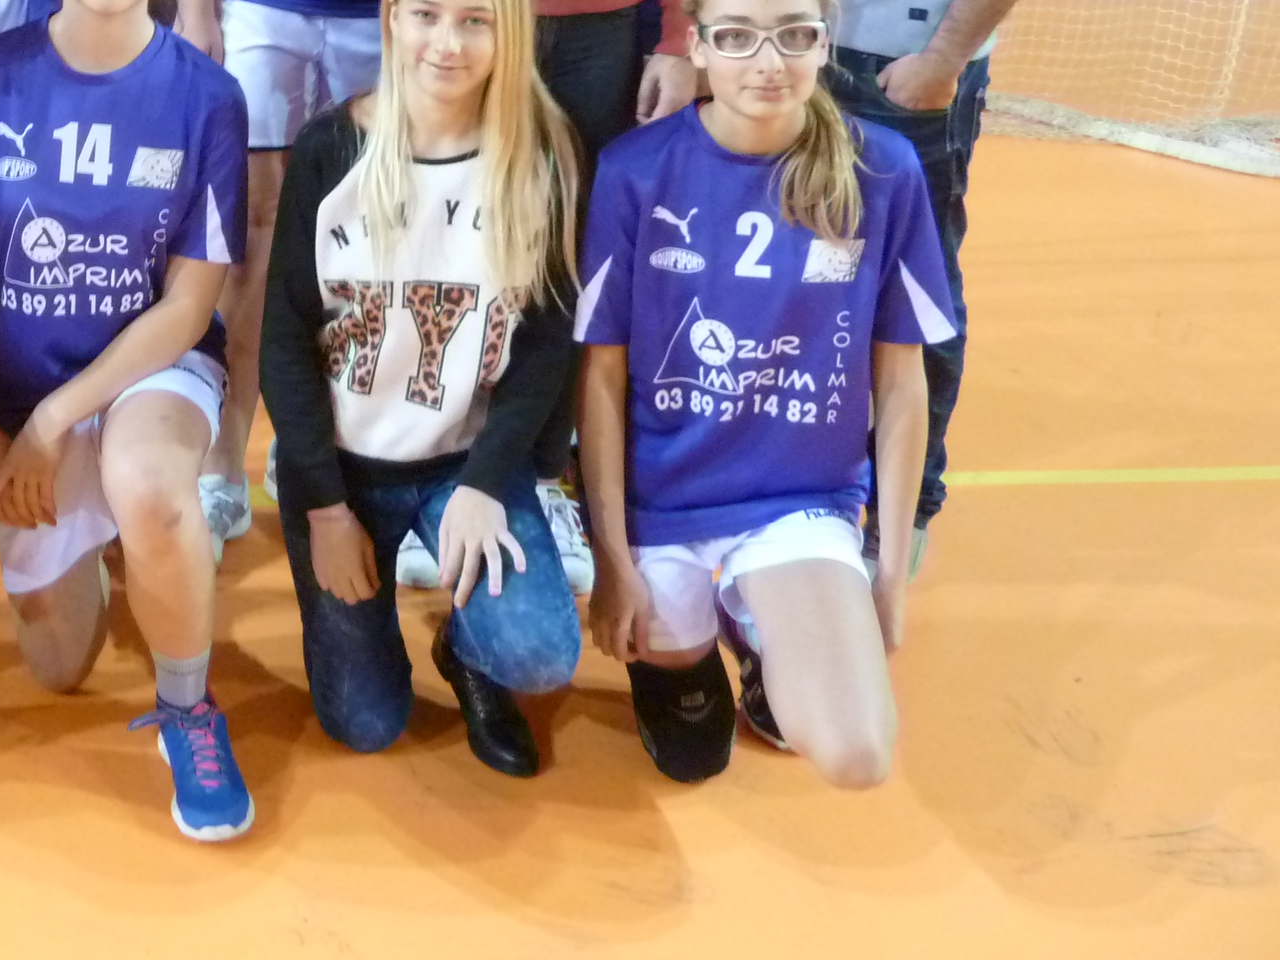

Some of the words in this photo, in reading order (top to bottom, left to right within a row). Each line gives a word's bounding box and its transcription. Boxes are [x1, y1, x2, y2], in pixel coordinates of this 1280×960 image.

[52, 121, 113, 186] 14
[734, 211, 774, 279] 2
[30, 263, 142, 289] IMPRIM
[22, 292, 47, 317] 89
[53, 293, 77, 317] 21
[88, 294, 114, 317] 14
[120, 291, 144, 313] 82
[698, 365, 816, 393] IMPRIM
[826, 310, 851, 424] COLMAR
[654, 387, 684, 411] 03
[689, 390, 714, 417] 89
[753, 393, 779, 418] 14
[786, 398, 817, 424] 82
